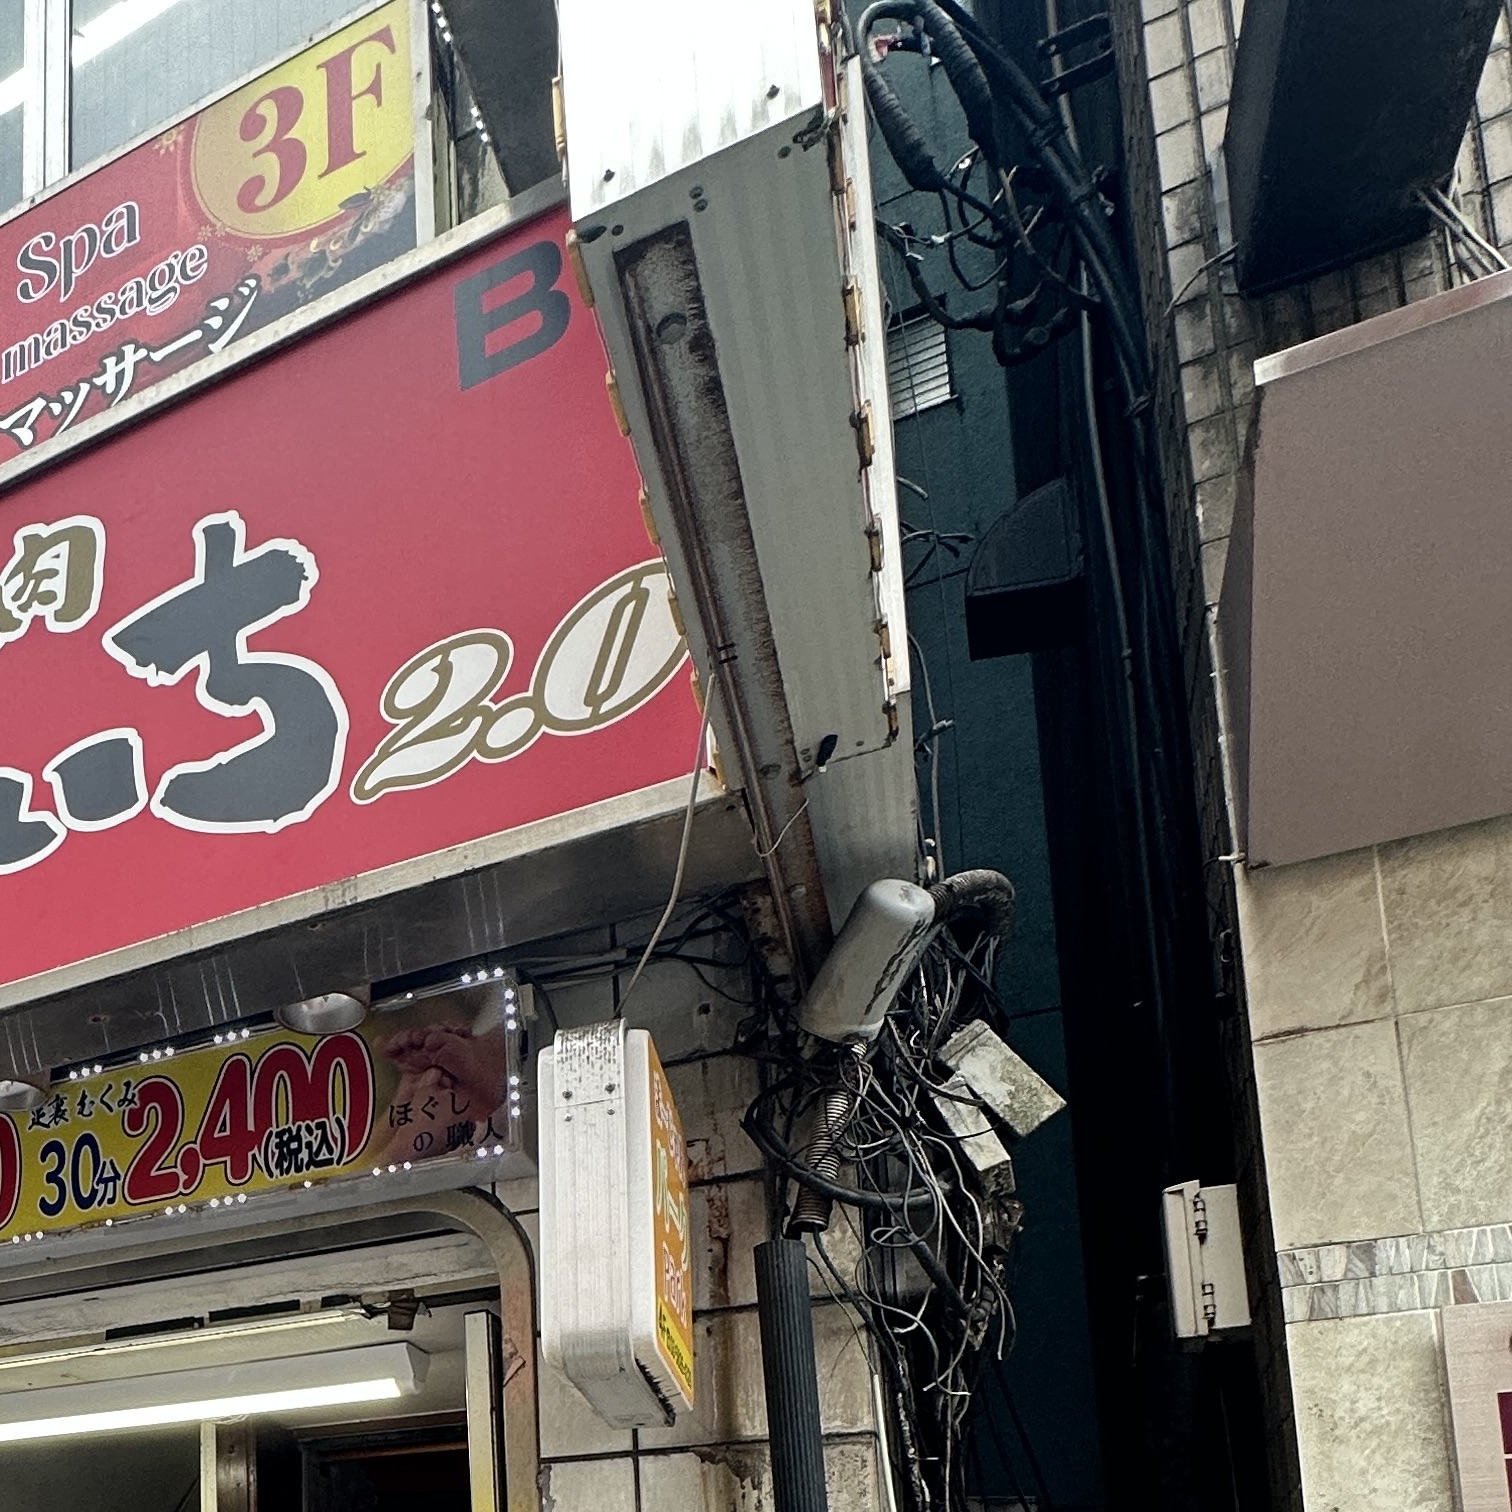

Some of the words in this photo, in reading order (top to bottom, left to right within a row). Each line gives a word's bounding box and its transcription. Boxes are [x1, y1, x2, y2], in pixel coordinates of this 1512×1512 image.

[234, 24, 398, 217] 3F
[0, 239, 209, 386] massage
[15, 199, 142, 303] Spa
[350, 558, 692, 806] 2.0
[37, 1131, 122, 1219] 30分
[121, 1028, 376, 1208] 2,400
[262, 1116, 350, 1180] (税込)
[387, 1088, 472, 1129] ほぐし
[413, 1117, 504, 1154] の職人
